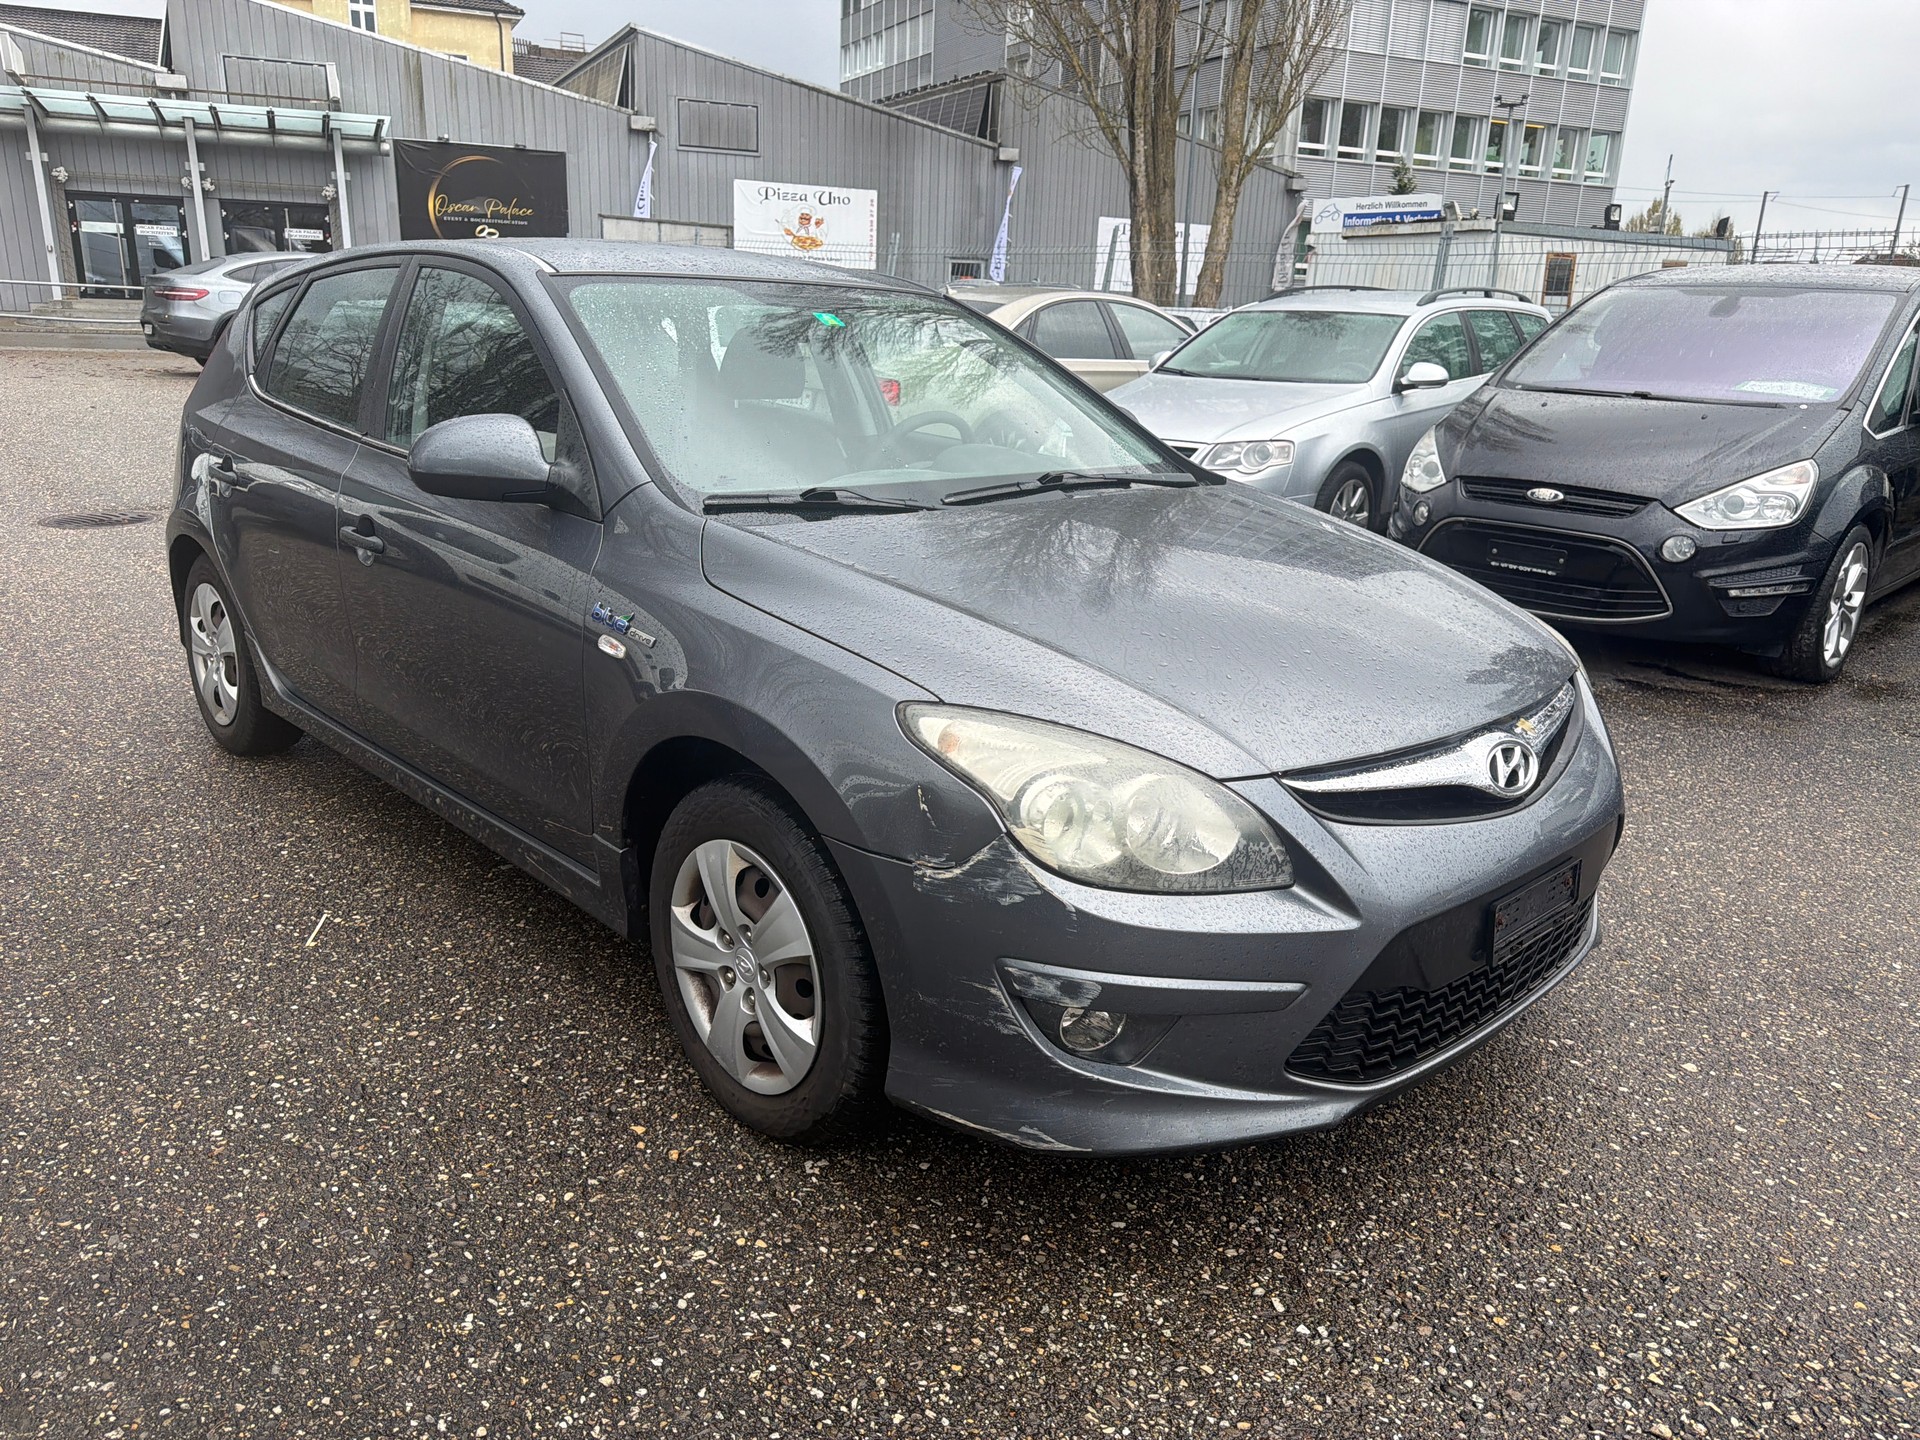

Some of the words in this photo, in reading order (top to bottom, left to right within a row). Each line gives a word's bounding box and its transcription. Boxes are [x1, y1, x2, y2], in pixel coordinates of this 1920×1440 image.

[757, 186, 808, 205] Pizza
[813, 189, 851, 206] Uno
[435, 194, 480, 217] Oscar
[484, 197, 535, 220] Palace
[1355, 202, 1383, 211] Herzlich
[1385, 200, 1428, 209] Willkommen
[470, 217, 528, 226] HOCHZEITSLOCATION
[1395, 215, 1401, 223] &
[591, 601, 629, 634] blue
[630, 630, 651, 645] drive
